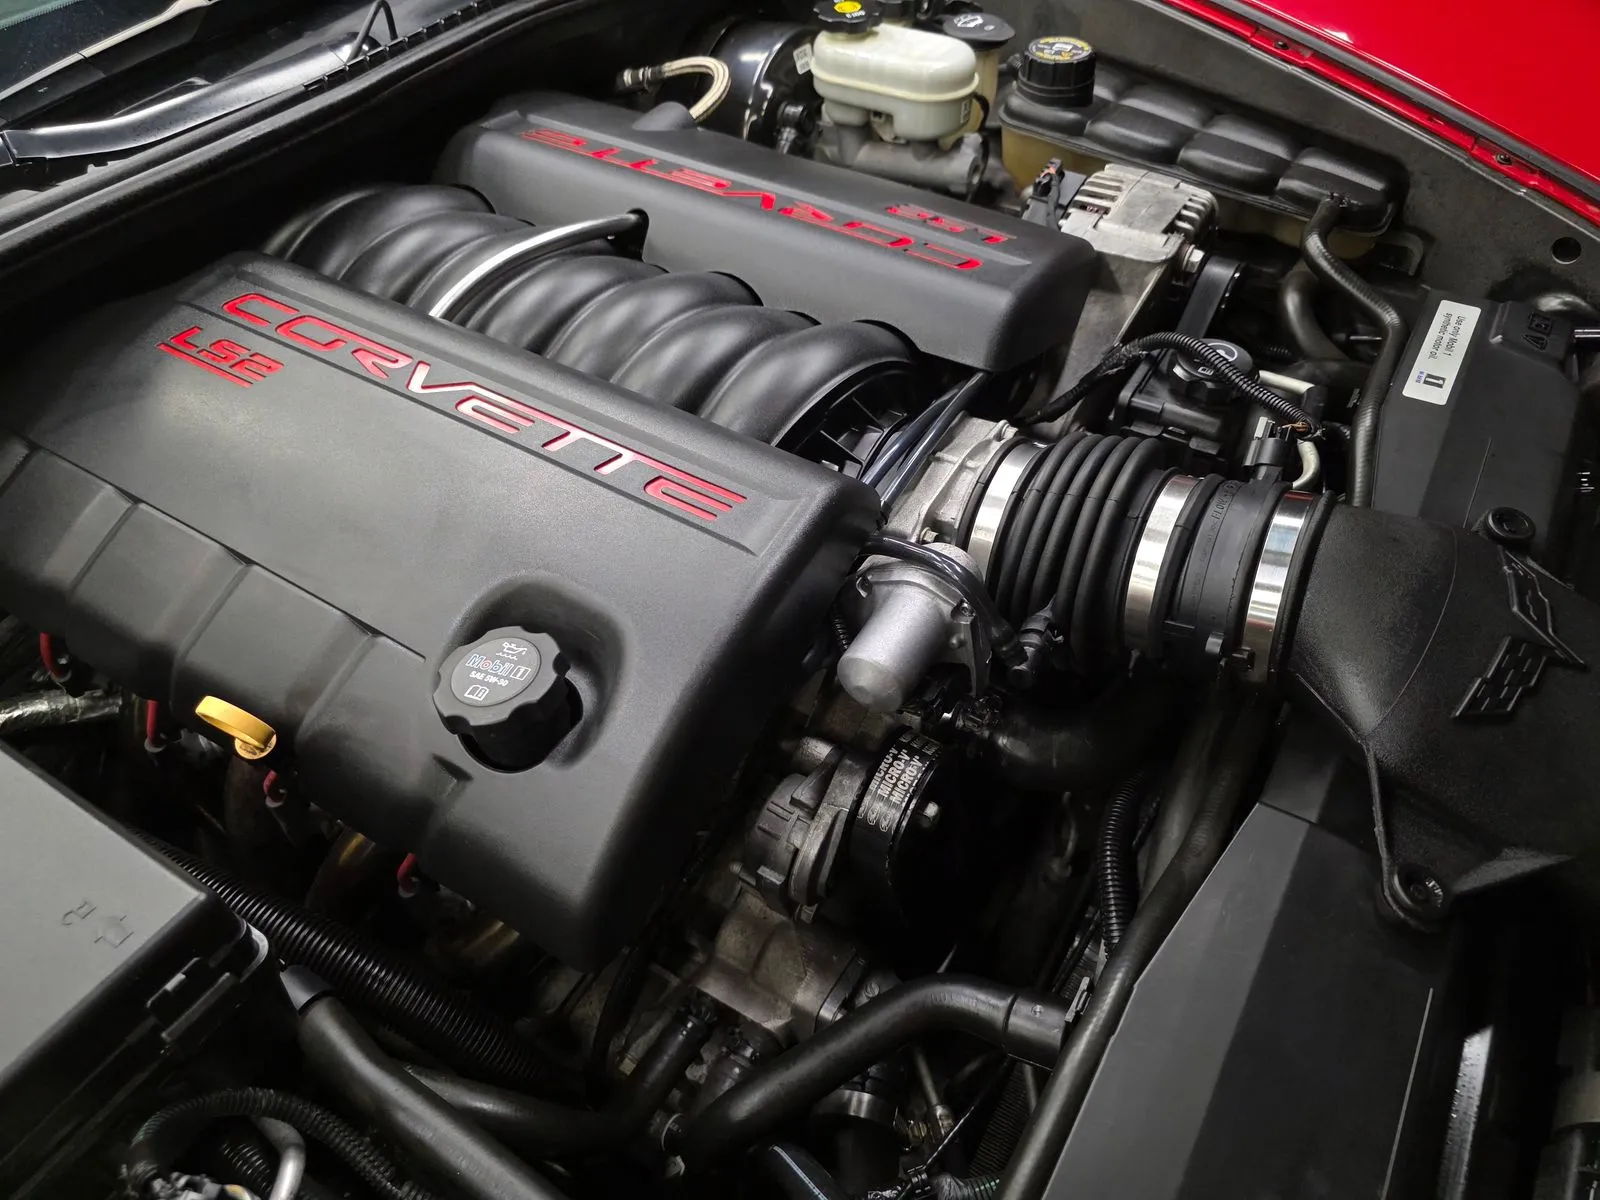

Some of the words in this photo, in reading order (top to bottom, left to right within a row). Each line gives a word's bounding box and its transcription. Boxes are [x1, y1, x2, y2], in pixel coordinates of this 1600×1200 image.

[520, 128, 983, 271] CORVETTE
[885, 204, 1012, 244] LS2
[1438, 312, 1453, 337] synthetic
[1456, 315, 1467, 326] Use
[1432, 336, 1444, 351] motor
[1448, 326, 1461, 339] only
[168, 325, 285, 382] LS2
[1446, 338, 1458, 353] Mobil
[222, 292, 747, 521] CORVETTE
[465, 653, 514, 676] Mobil
[469, 670, 485, 681] SAE
[484, 675, 509, 687] 5W-30
